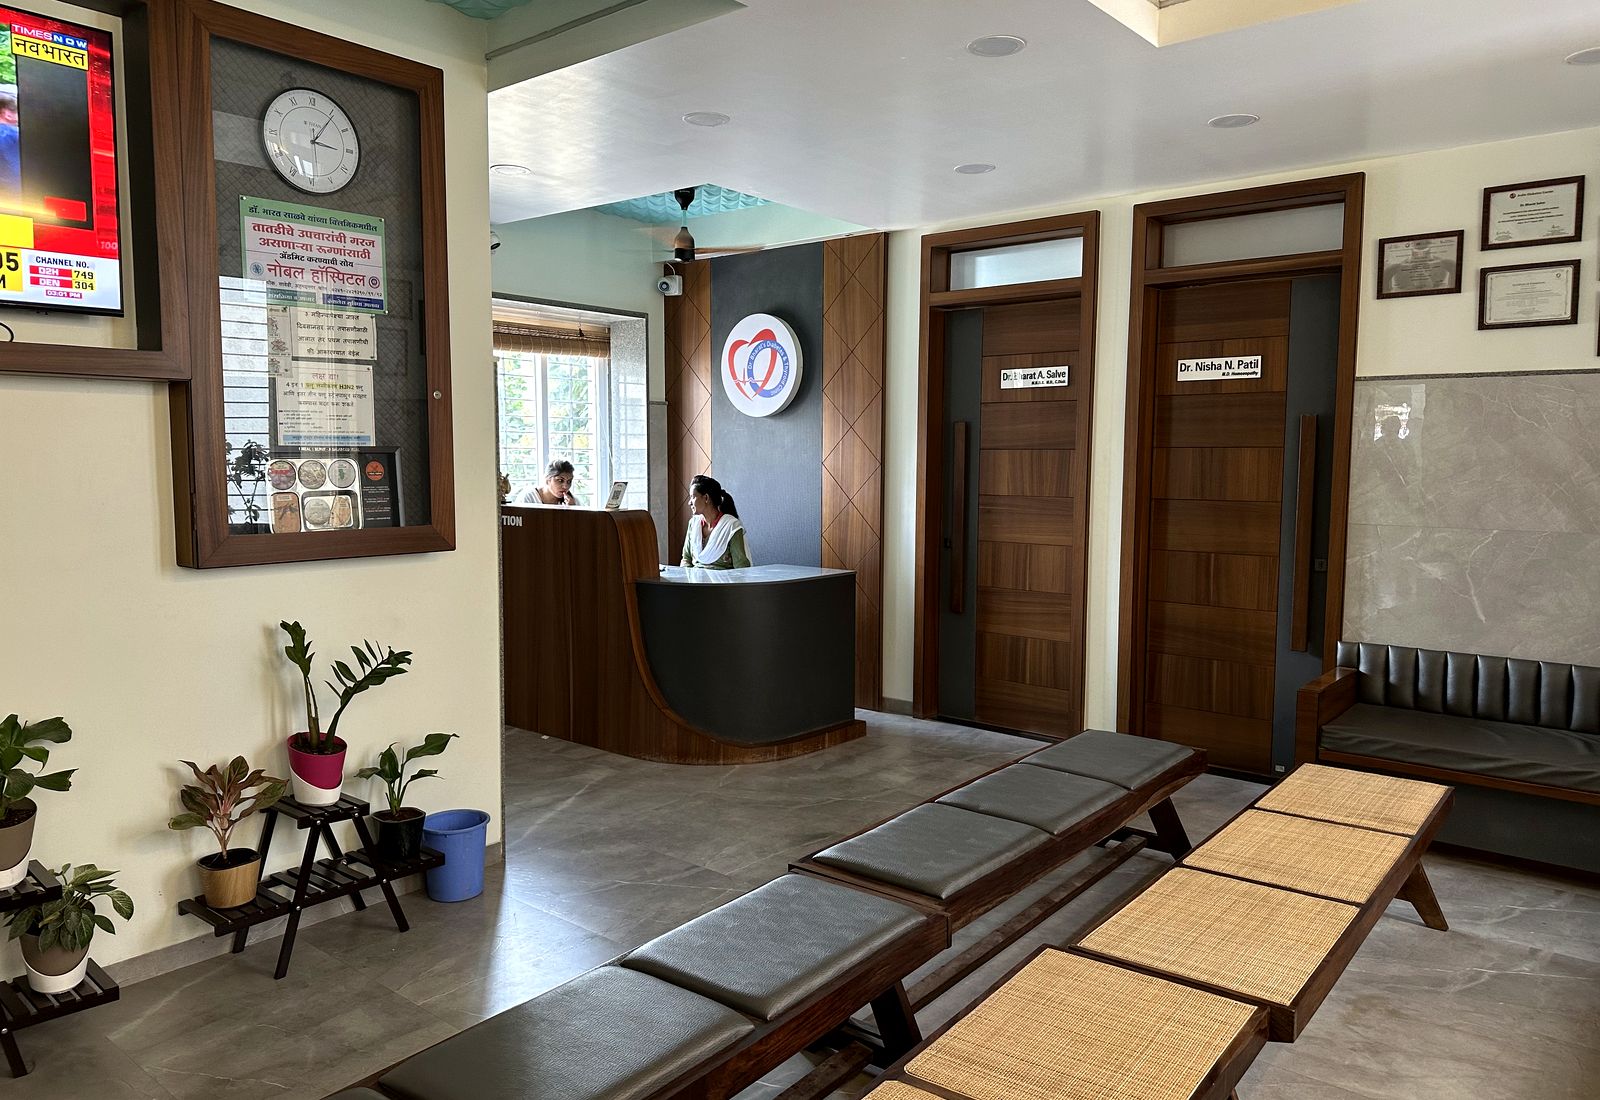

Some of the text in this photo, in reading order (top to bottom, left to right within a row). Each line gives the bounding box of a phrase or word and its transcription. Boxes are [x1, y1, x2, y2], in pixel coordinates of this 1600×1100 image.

[12, 24, 88, 48] TIMES NOW
[14, 38, 86, 66] नवभारत
[252, 223, 376, 247] तातडीचे उपचारांची गरज
[36, 256, 72, 267] CHANNEL
[74, 270, 94, 280] 749
[267, 259, 366, 286] नोबल हॉस्पिटल
[74, 281, 94, 290] 304
[1180, 359, 1258, 372] Dr. Nisha N. Patil
[1003, 372, 1012, 380] Dr.
[1038, 371, 1045, 379] A.
[1046, 370, 1066, 378] Salve
